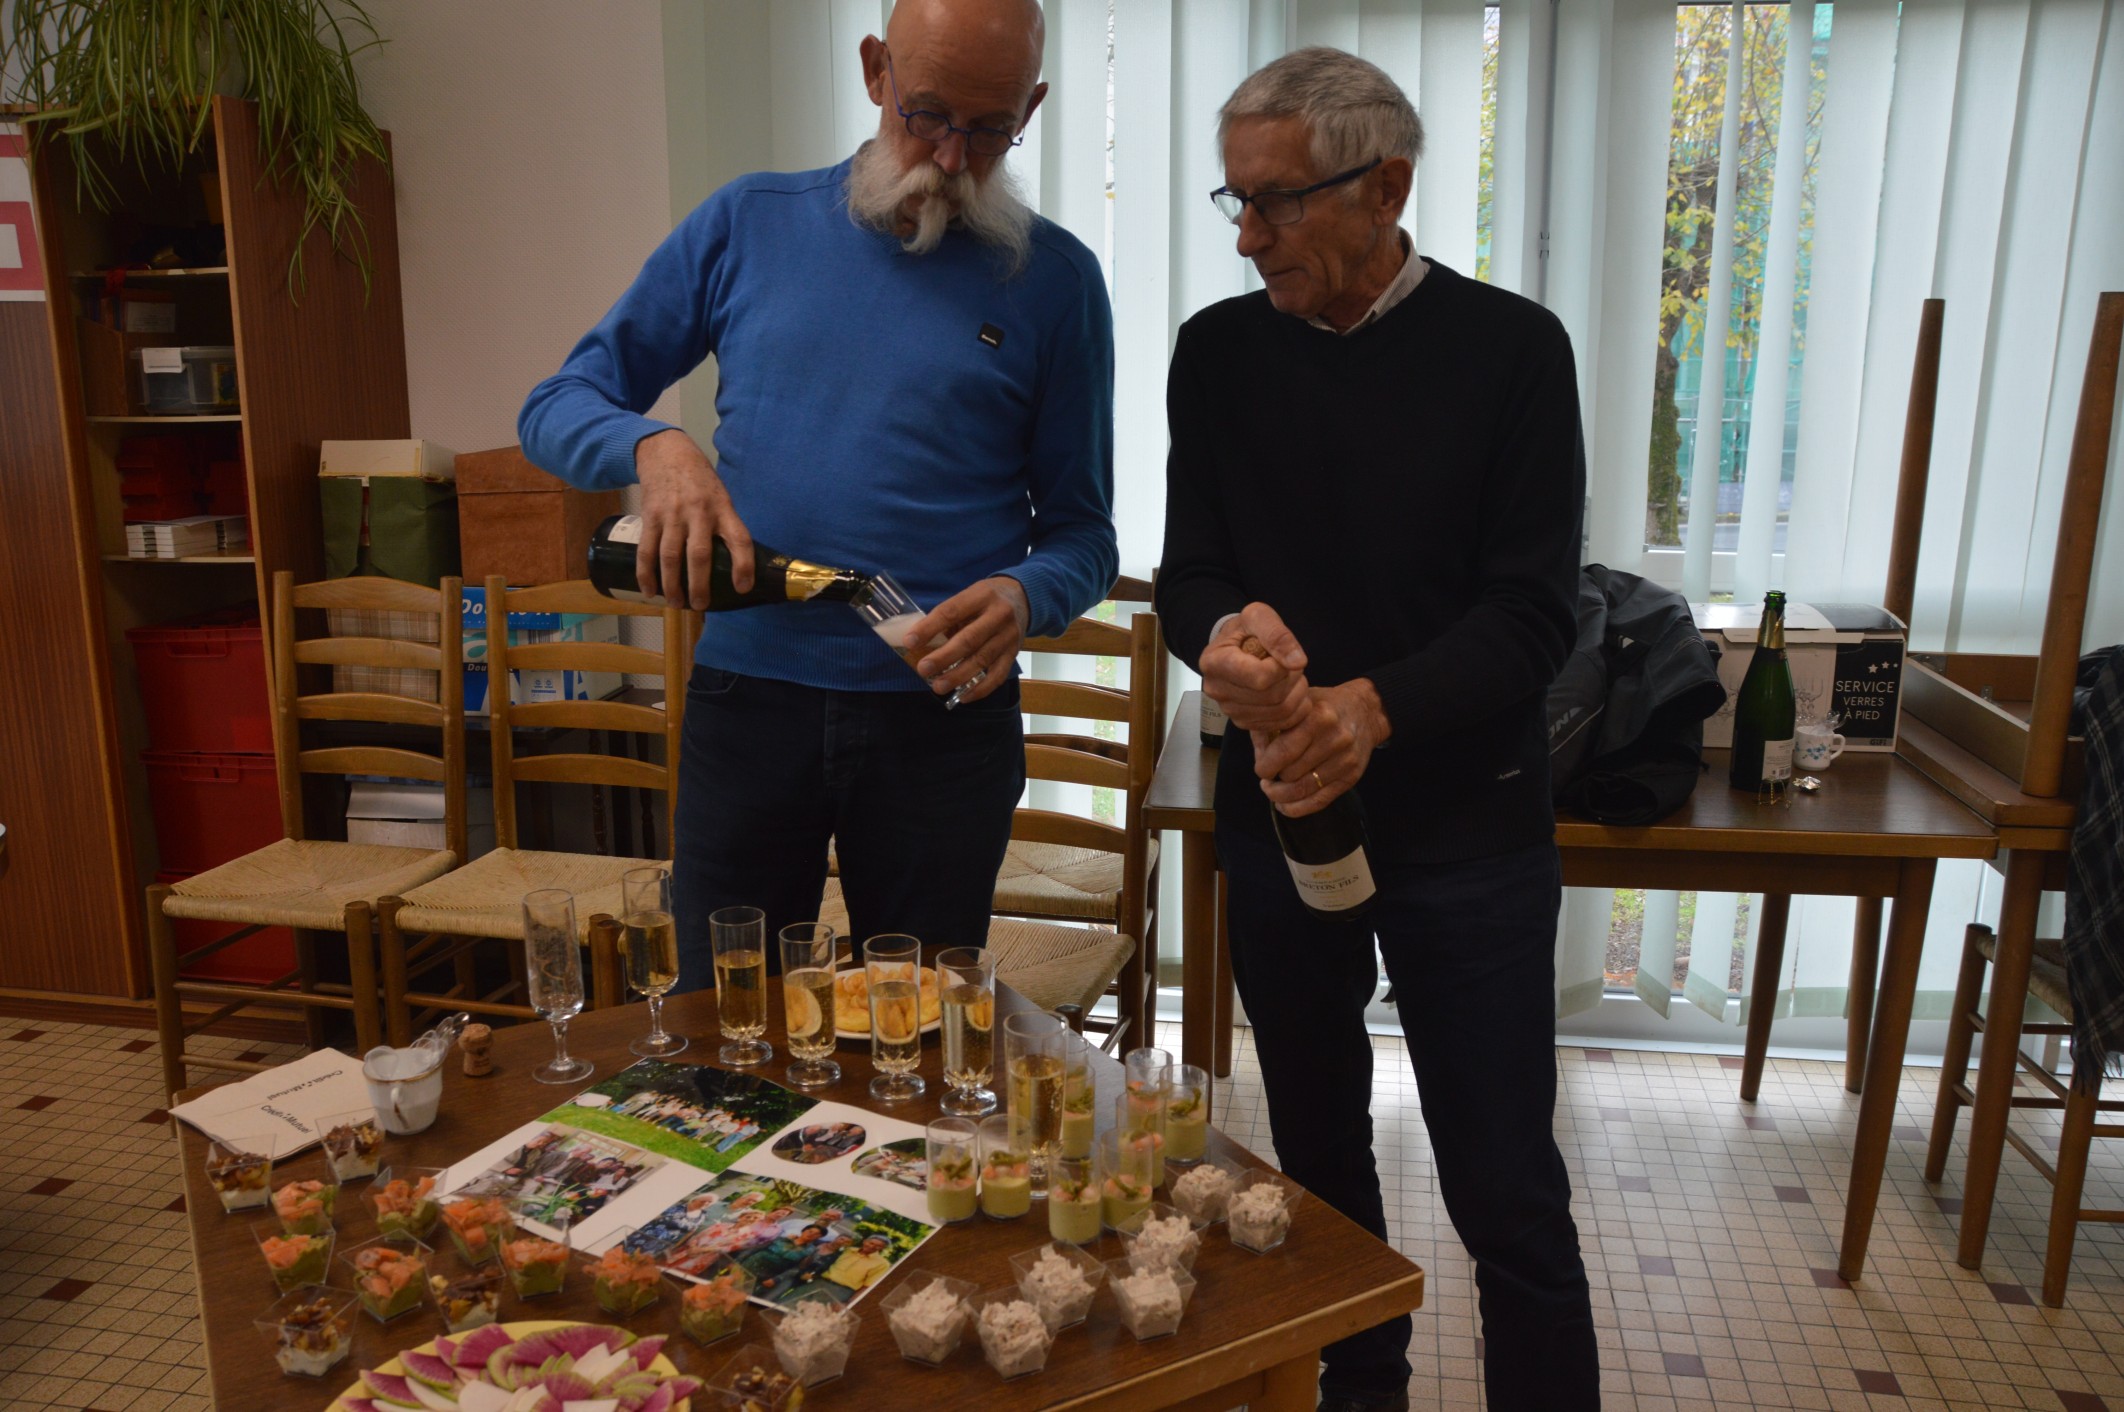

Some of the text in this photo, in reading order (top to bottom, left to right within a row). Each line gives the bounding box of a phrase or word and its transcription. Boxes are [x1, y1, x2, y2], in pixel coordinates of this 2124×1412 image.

[1835, 681, 1895, 693] SERVICE
[1843, 697, 1885, 707] VERRES
[1844, 707, 1880, 720] À PIED
